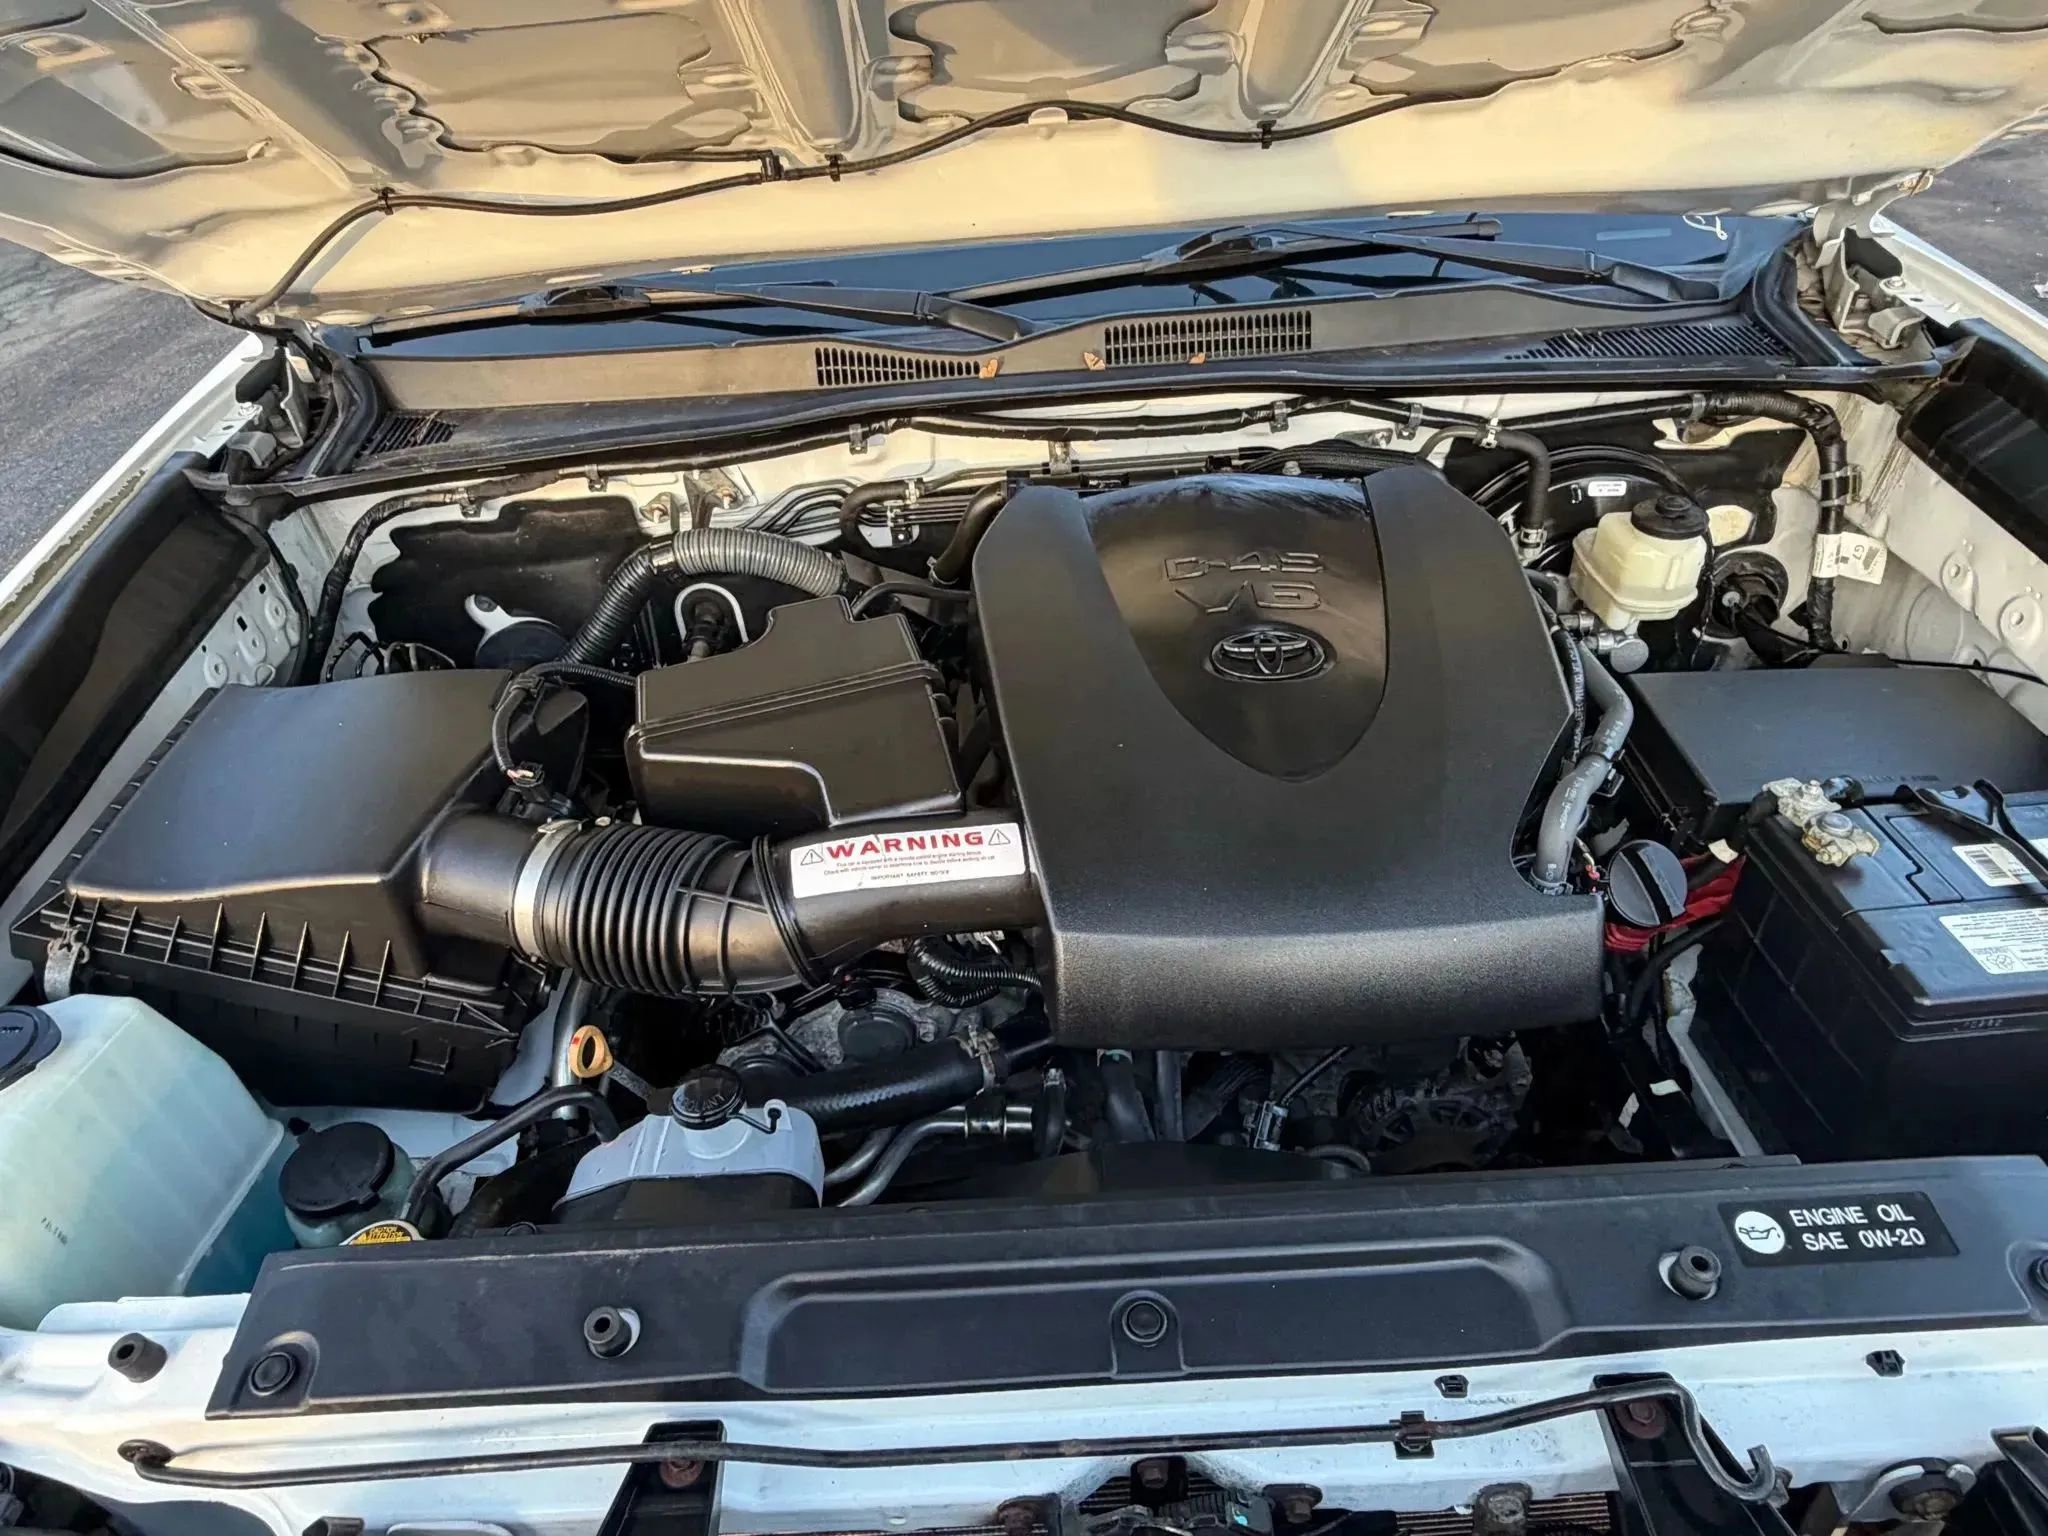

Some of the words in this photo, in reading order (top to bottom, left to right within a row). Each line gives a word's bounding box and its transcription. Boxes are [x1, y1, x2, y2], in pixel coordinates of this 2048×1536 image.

[827, 831, 984, 860] WARNING
[1789, 1206, 1868, 1228] ENGINE
[1876, 1203, 1916, 1223] OIL
[1801, 1231, 1849, 1252] SAE
[1858, 1227, 1926, 1249] 0W-20
